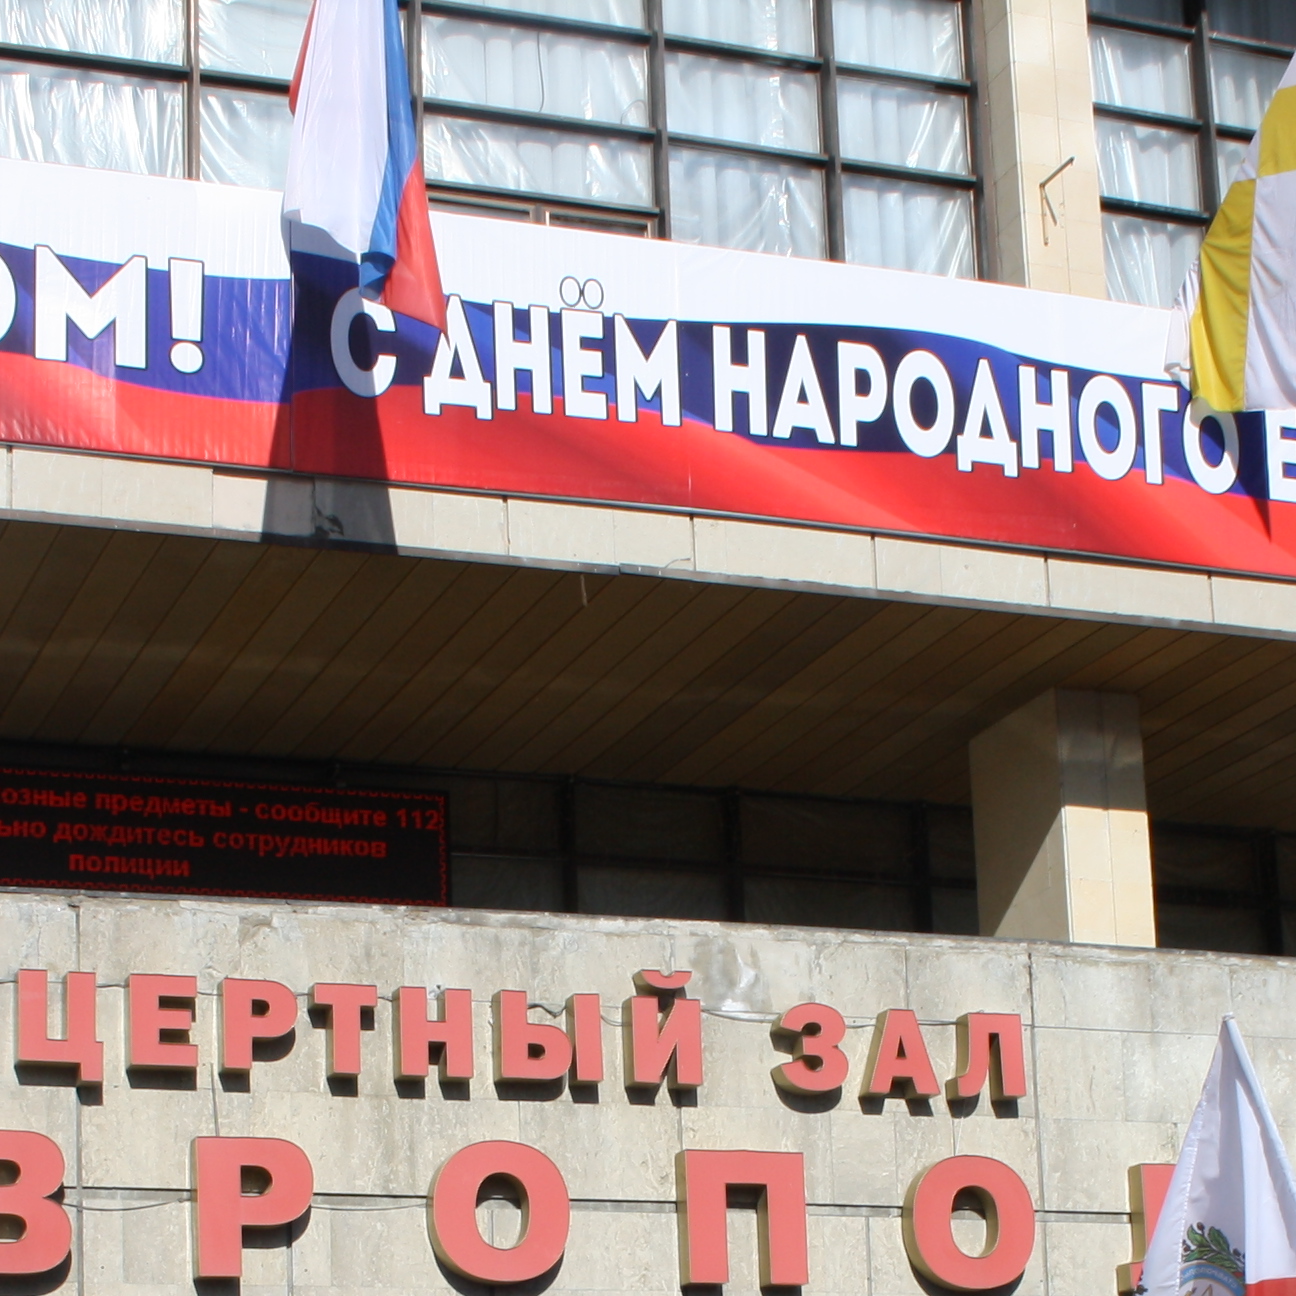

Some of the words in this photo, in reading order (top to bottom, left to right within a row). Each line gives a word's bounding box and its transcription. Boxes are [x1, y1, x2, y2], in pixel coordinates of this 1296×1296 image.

[330, 286, 398, 397] С
[422, 276, 683, 428] ДНЁМ
[712, 324, 1240, 495] НАРОДНОГО
[95, 791, 232, 818] предметы
[255, 801, 388, 829] сообщите
[396, 808, 440, 831] 112
[53, 820, 204, 848] дождитесь
[213, 830, 388, 858] сотрудников
[69, 853, 190, 880] полиции
[771, 1002, 1026, 1099] ЗАЛ
